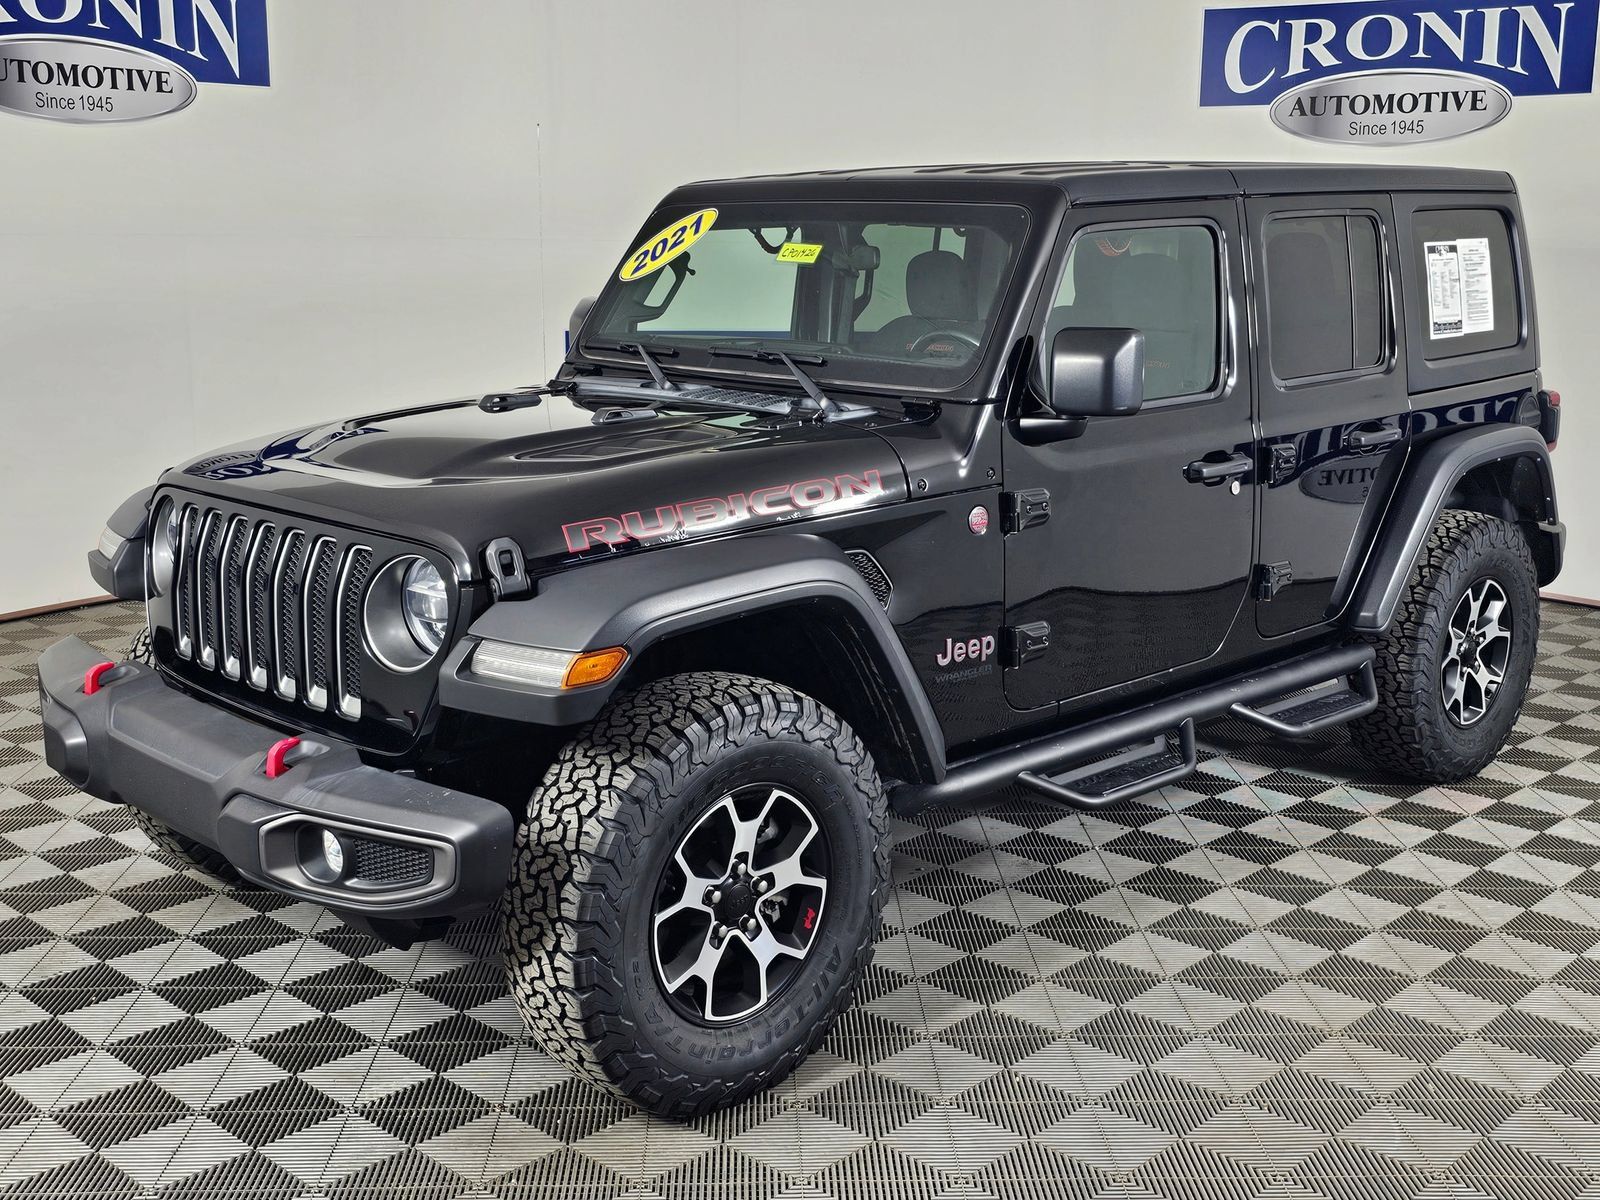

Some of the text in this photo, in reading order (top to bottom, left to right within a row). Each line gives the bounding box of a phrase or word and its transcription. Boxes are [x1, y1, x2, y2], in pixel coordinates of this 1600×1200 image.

[1223, 2, 1575, 94] CRONIN
[35, 91, 114, 112] Since 1945
[1288, 89, 1488, 118] AUTOMOTIVE
[1348, 119, 1425, 136] Since 1945
[630, 213, 704, 277] 2021
[561, 469, 885, 553] RUBICON
[936, 635, 995, 667] Jeep
[934, 664, 993, 683] WRANGLER
